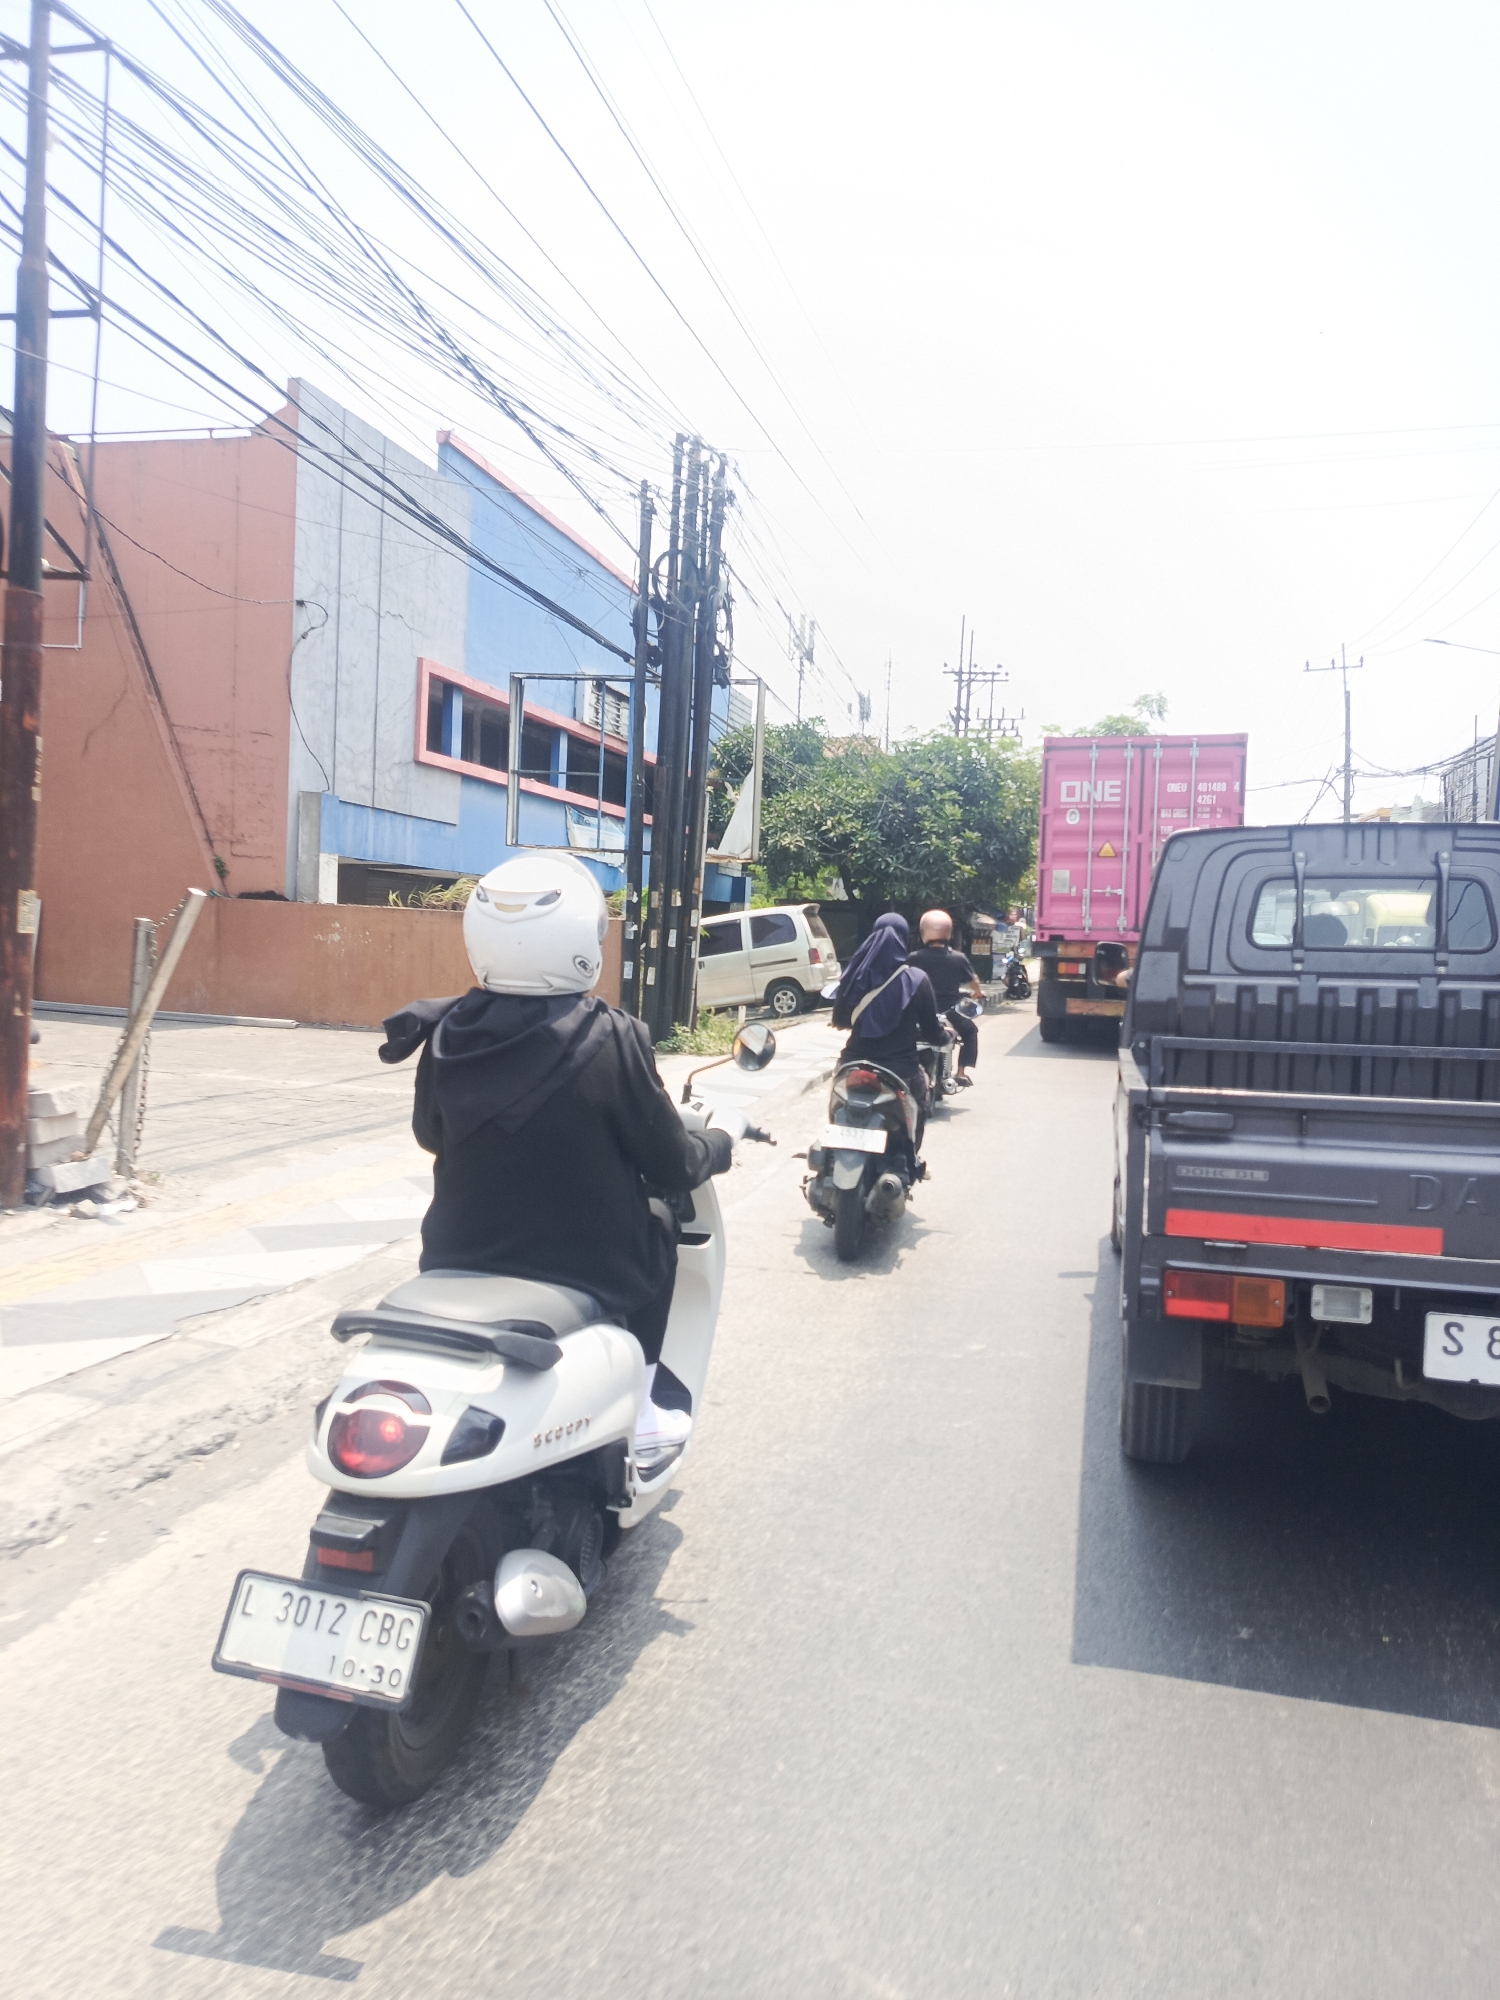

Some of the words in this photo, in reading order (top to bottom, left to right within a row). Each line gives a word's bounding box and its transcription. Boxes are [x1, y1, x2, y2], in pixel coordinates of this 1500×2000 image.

[1060, 780, 1121, 802] ONE
[1167, 782, 1188, 793] ONEU
[1178, 1166, 1230, 1178] DOHC
[1442, 1321, 1464, 1356] S
[1487, 1325, 1500, 1360] 8
[533, 1413, 592, 1449] SCOOPY
[241, 1584, 254, 1617] L
[276, 1591, 348, 1636] 3012
[358, 1609, 414, 1650] CBG
